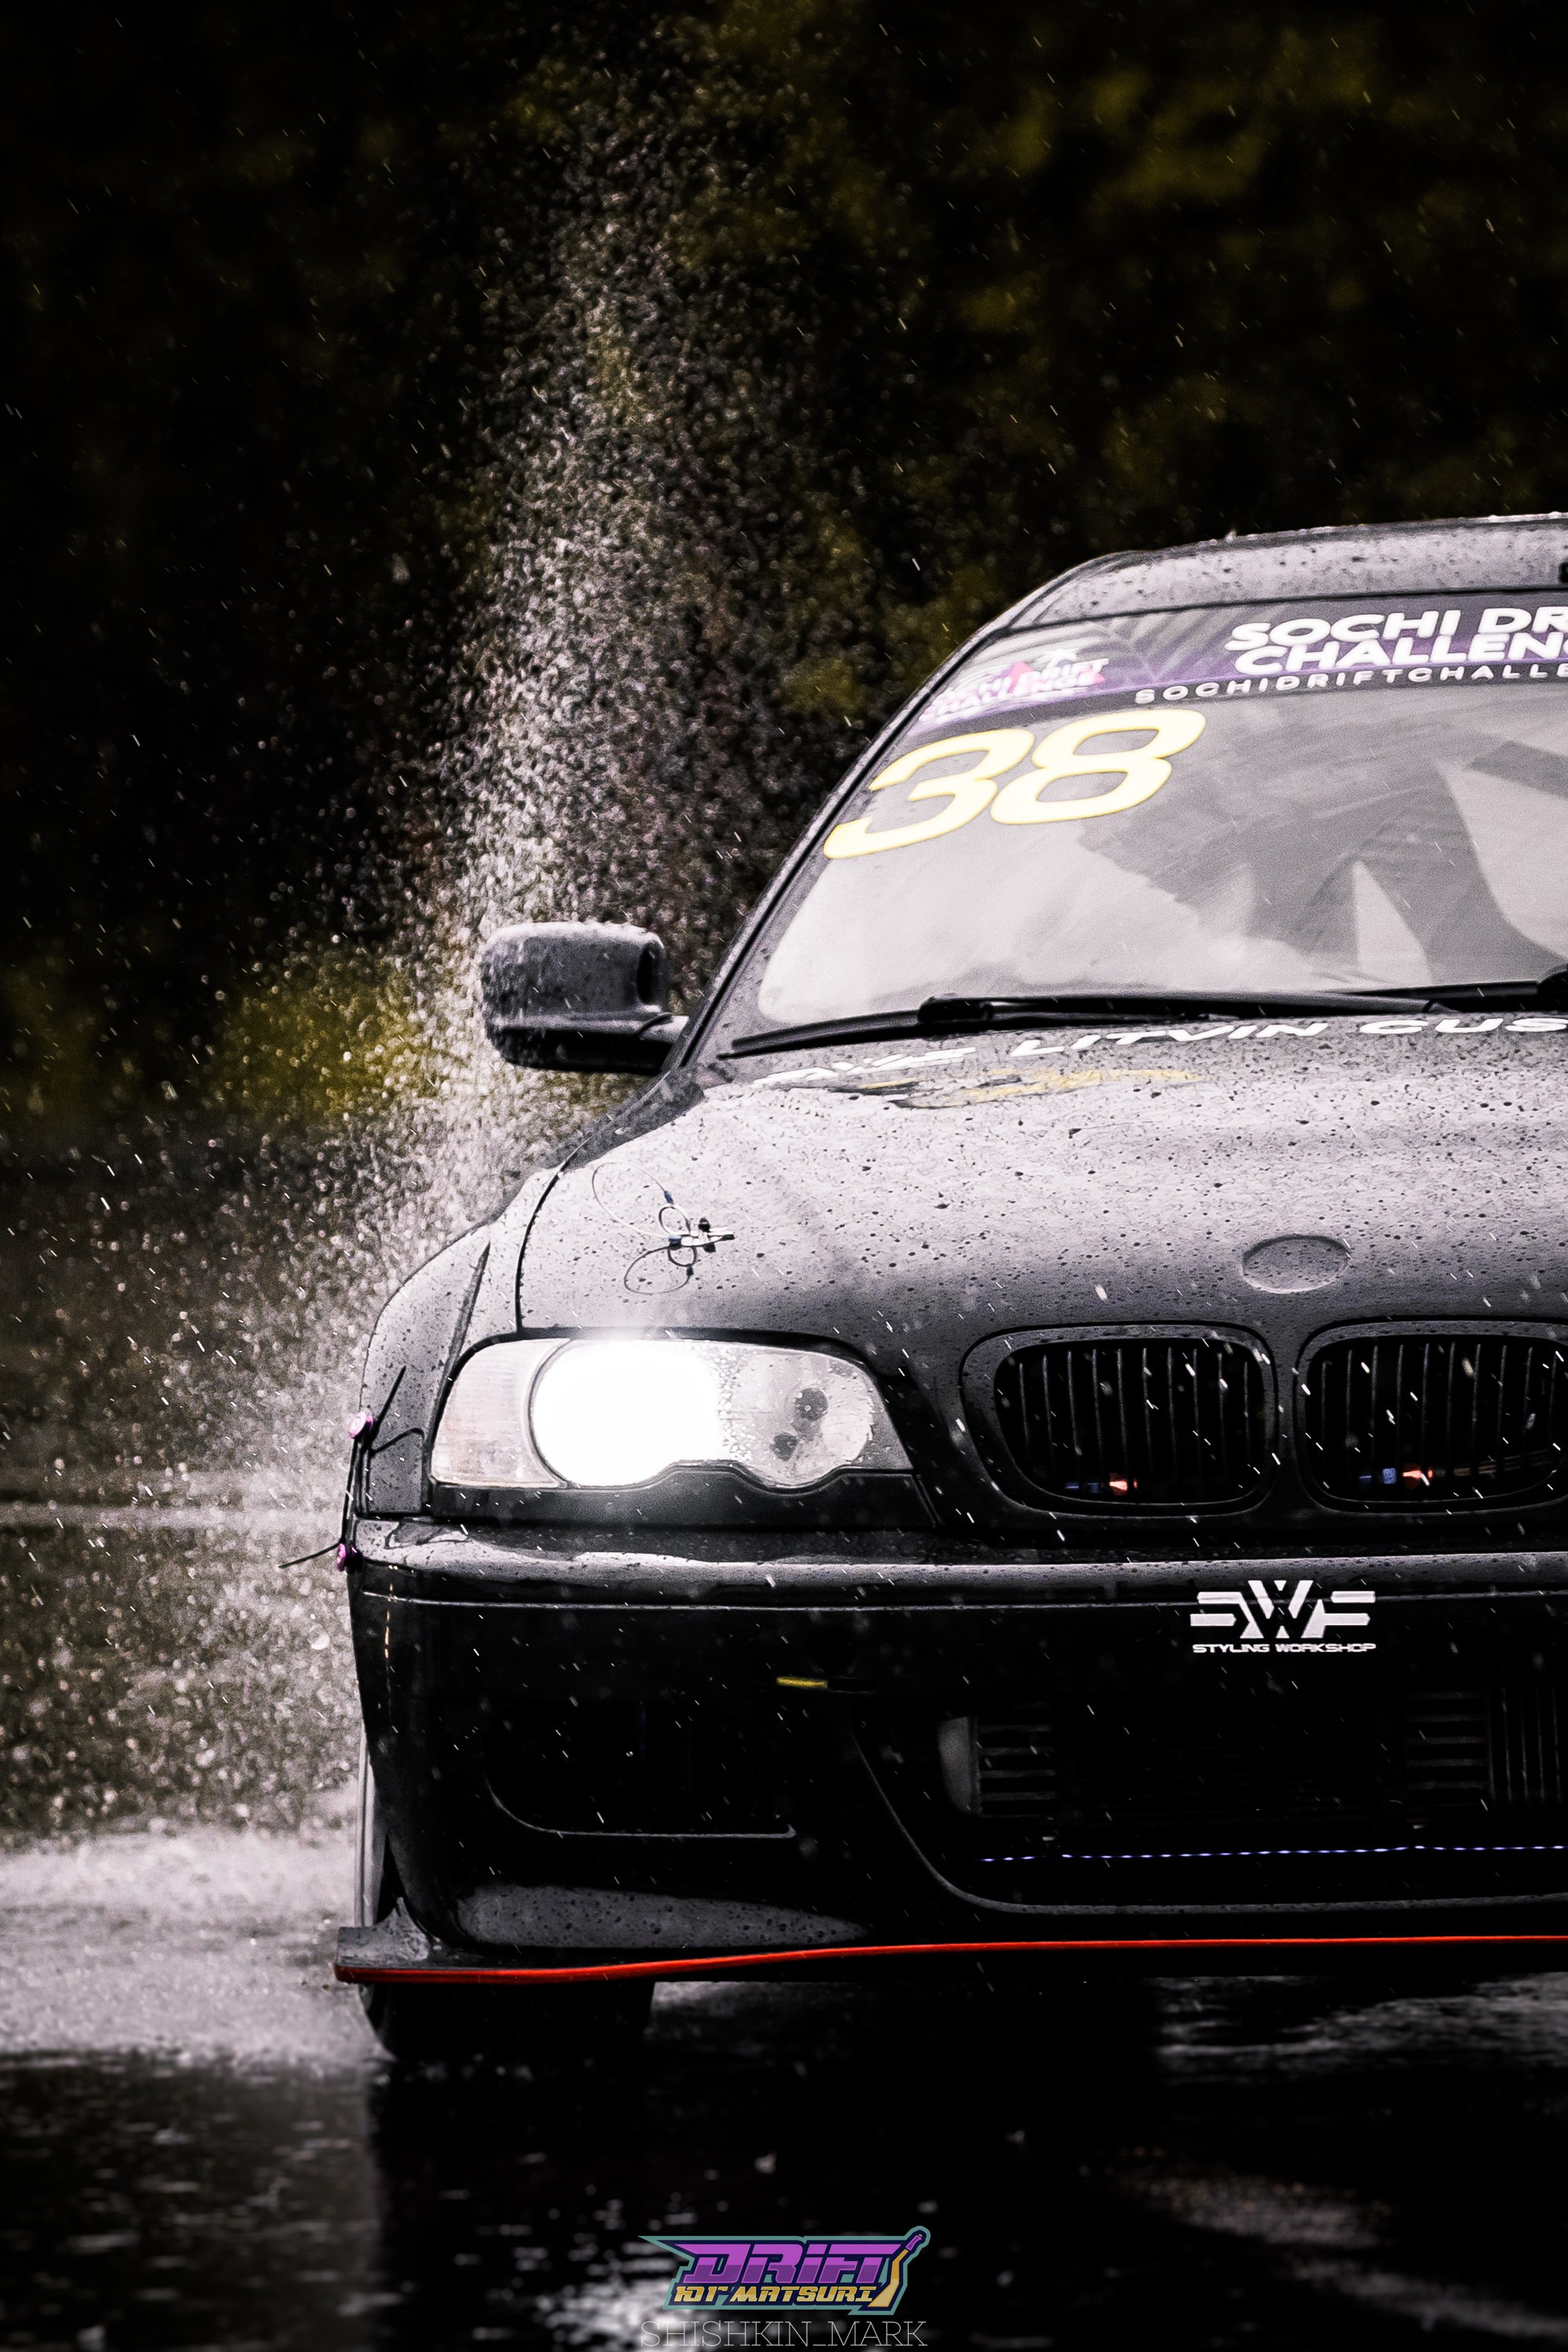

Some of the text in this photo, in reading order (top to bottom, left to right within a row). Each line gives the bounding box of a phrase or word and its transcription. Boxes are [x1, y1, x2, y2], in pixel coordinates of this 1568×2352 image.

[1225, 609, 1461, 651] SOCHI
[1235, 631, 1568, 675] CHALLEN
[823, 709, 1207, 859] 38
[1010, 1022, 1329, 1057] LITVIN
[1192, 1642, 1377, 1653] STYLING WORKSHOP
